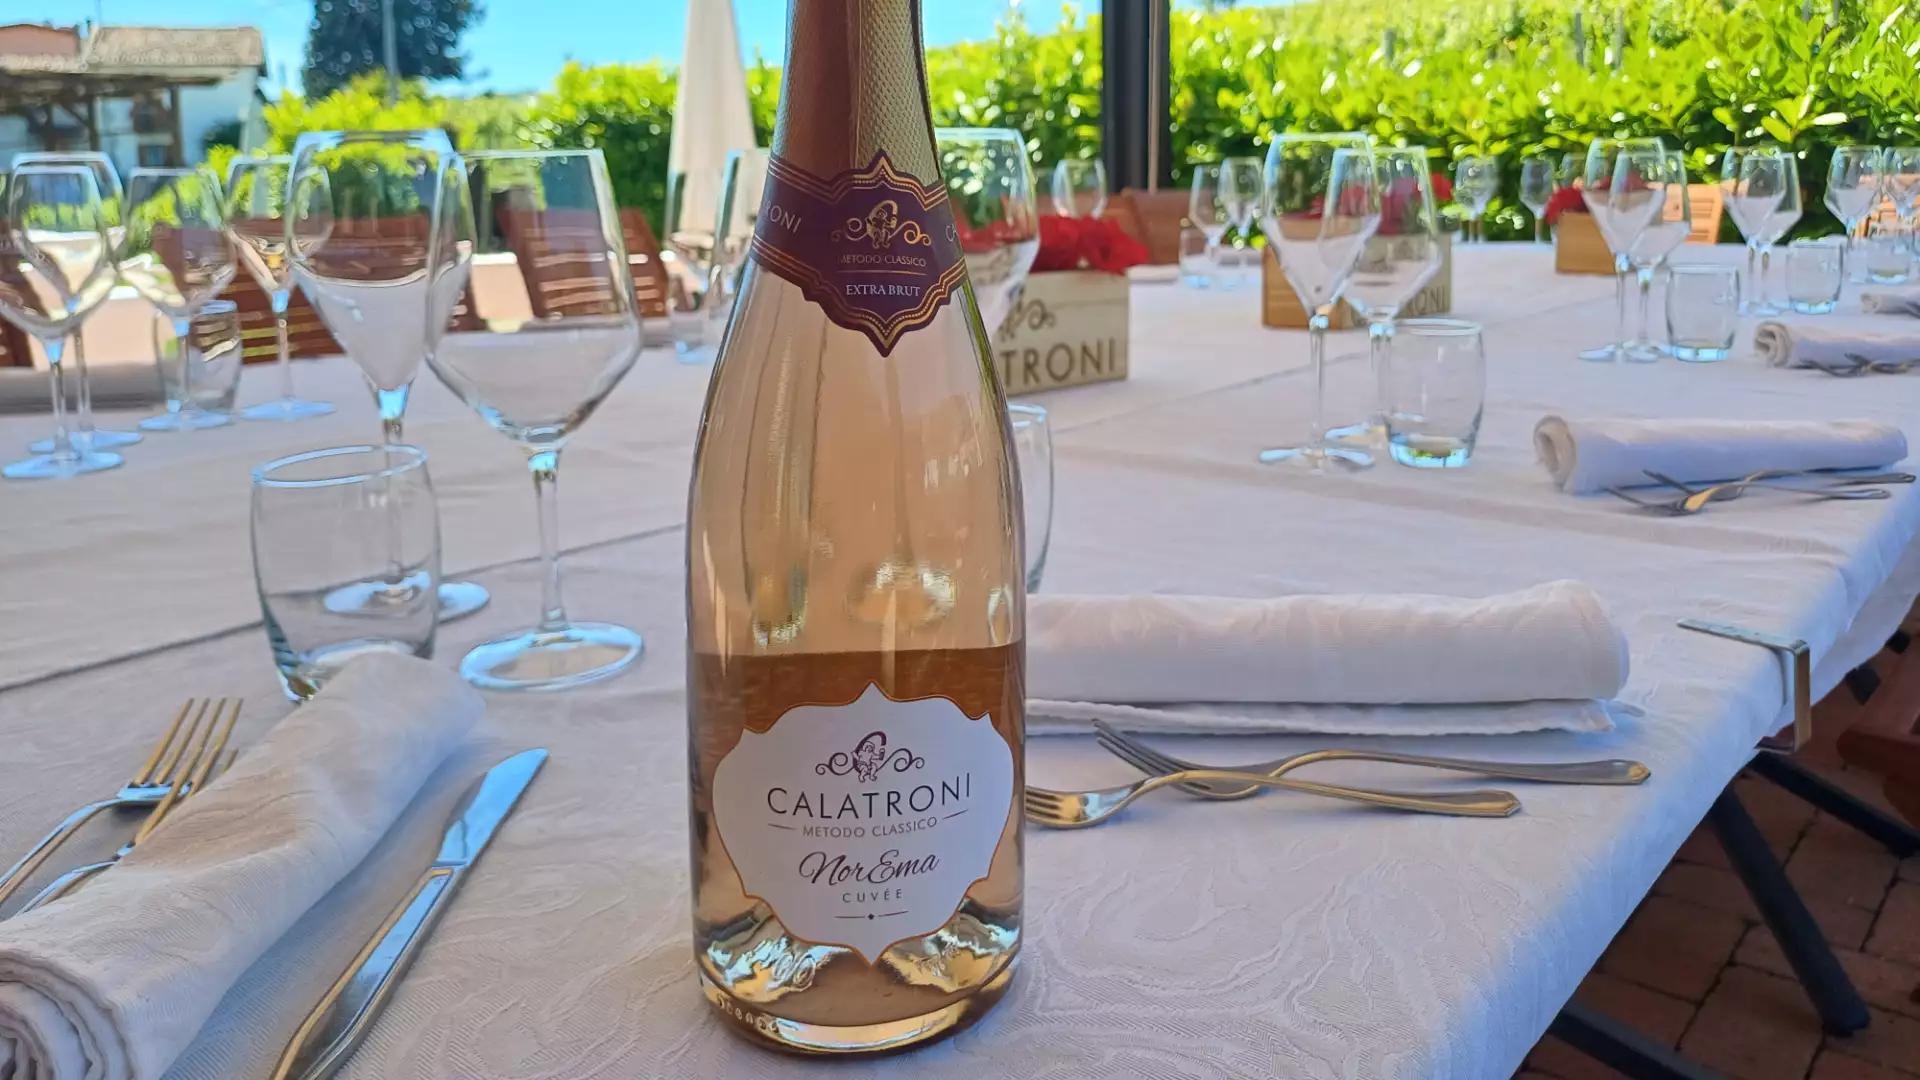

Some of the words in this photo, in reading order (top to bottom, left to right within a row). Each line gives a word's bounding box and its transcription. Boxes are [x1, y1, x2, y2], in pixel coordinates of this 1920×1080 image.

[838, 254, 881, 266] METODO
[884, 255, 926, 267] CLASSICO
[846, 284, 886, 296] EXTRA
[888, 285, 921, 297] BRUT
[767, 773, 970, 819] CALATRONI
[803, 824, 866, 838] METODO
[872, 816, 937, 836] CLASSICO
[799, 849, 940, 886] NorEma
[842, 888, 903, 903] CUVÉE
